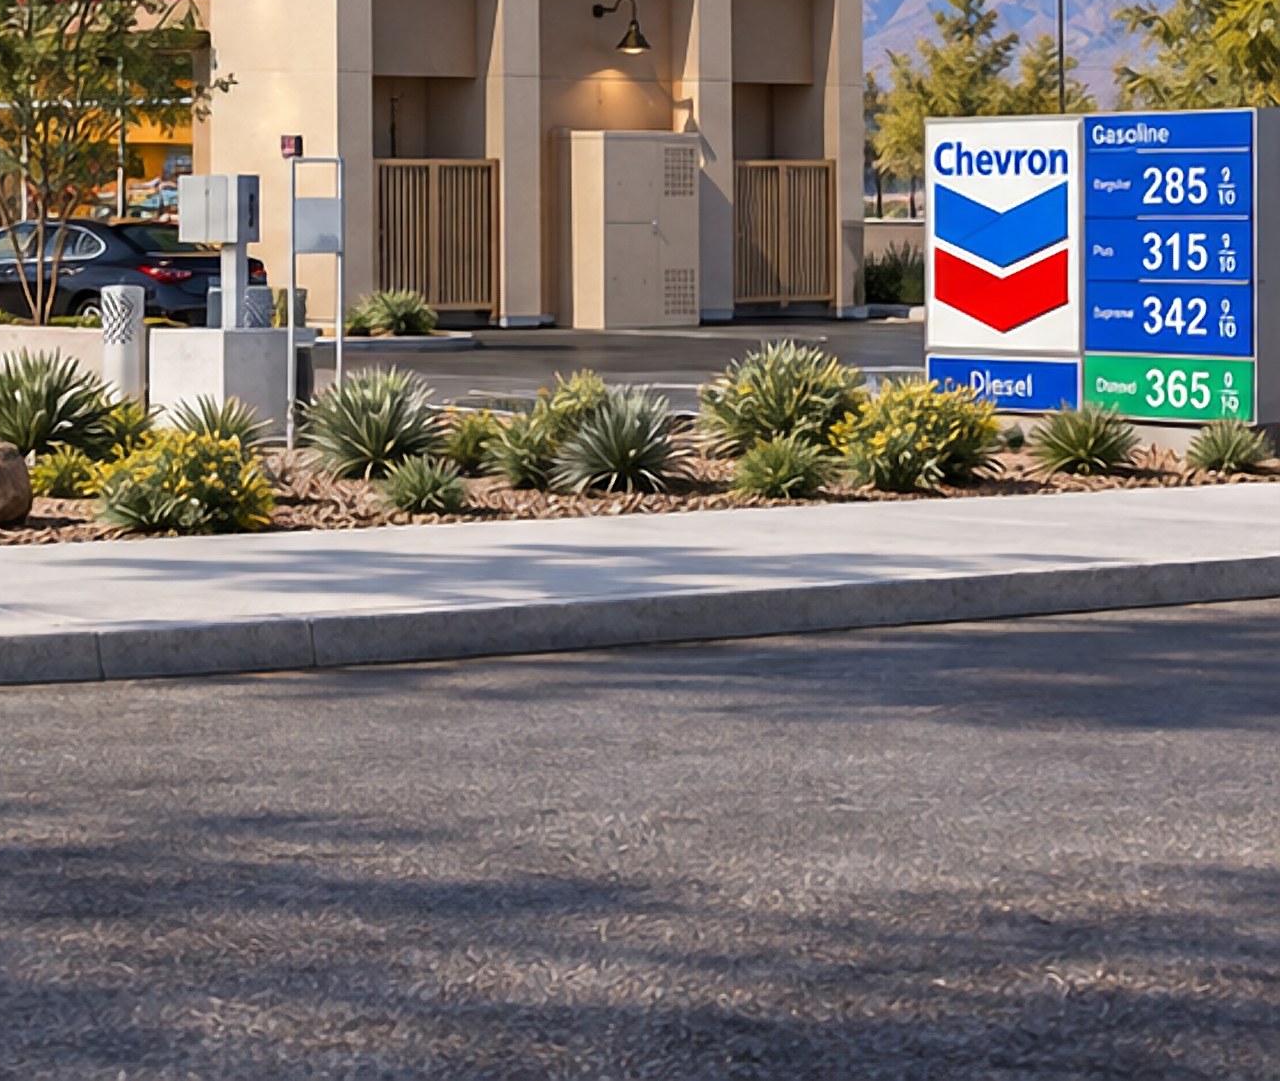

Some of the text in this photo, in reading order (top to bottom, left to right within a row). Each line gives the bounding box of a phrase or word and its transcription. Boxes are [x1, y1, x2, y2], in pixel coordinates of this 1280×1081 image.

[1091, 123, 1170, 145] Gasoline
[933, 141, 1069, 176] Chevron
[1142, 167, 1208, 204] 285
[1142, 232, 1208, 271] 315
[1143, 296, 1208, 335] 342
[970, 370, 1033, 397] Diesel
[1145, 368, 1211, 409] 365
